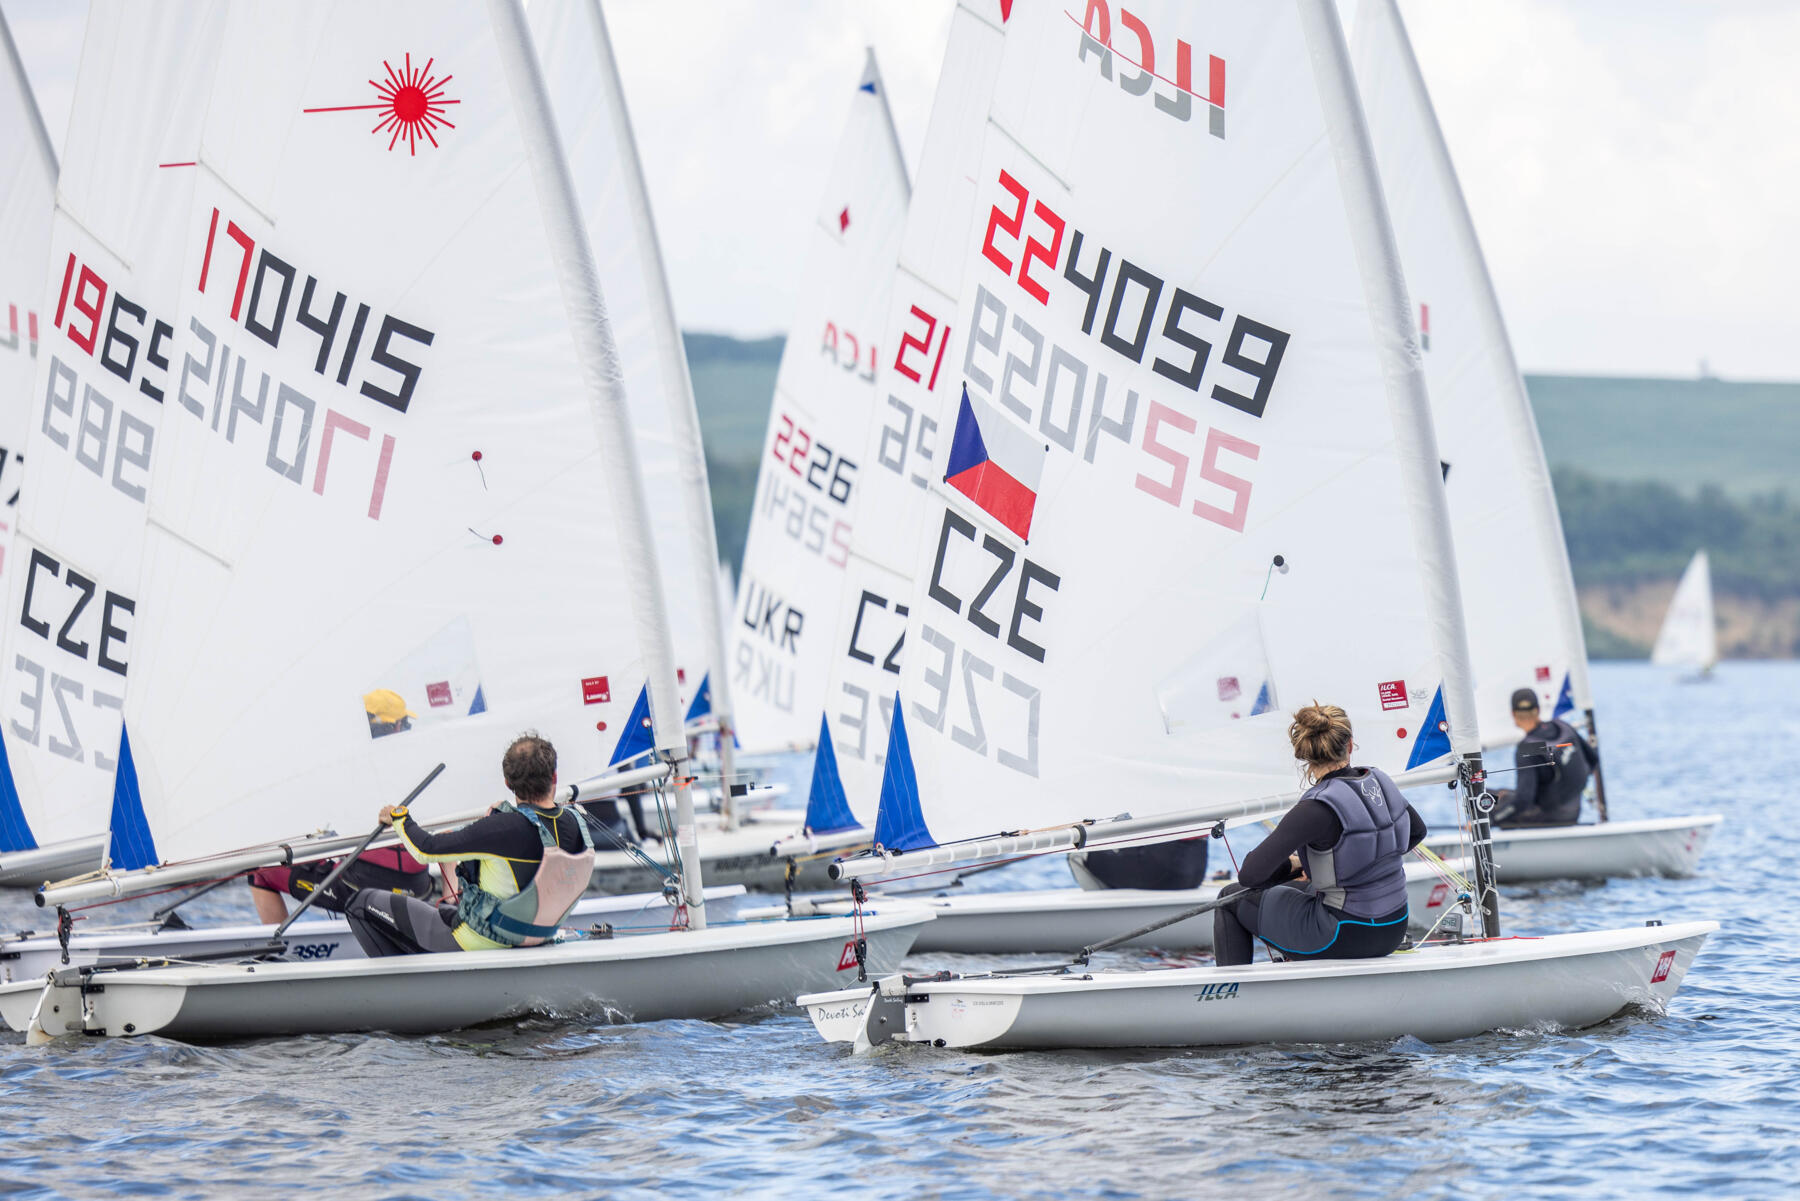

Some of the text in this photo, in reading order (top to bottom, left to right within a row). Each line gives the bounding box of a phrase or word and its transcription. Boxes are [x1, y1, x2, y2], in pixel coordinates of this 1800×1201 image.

[198, 207, 436, 414] 170415
[982, 168, 1291, 419] 224059
[894, 304, 950, 392] 21
[773, 413, 858, 505] 2226
[20, 547, 136, 678] CZE
[743, 579, 804, 656] UKR
[929, 507, 1061, 664] CZE
[279, 941, 339, 959] aser
[1194, 982, 1240, 1001] ILCA
